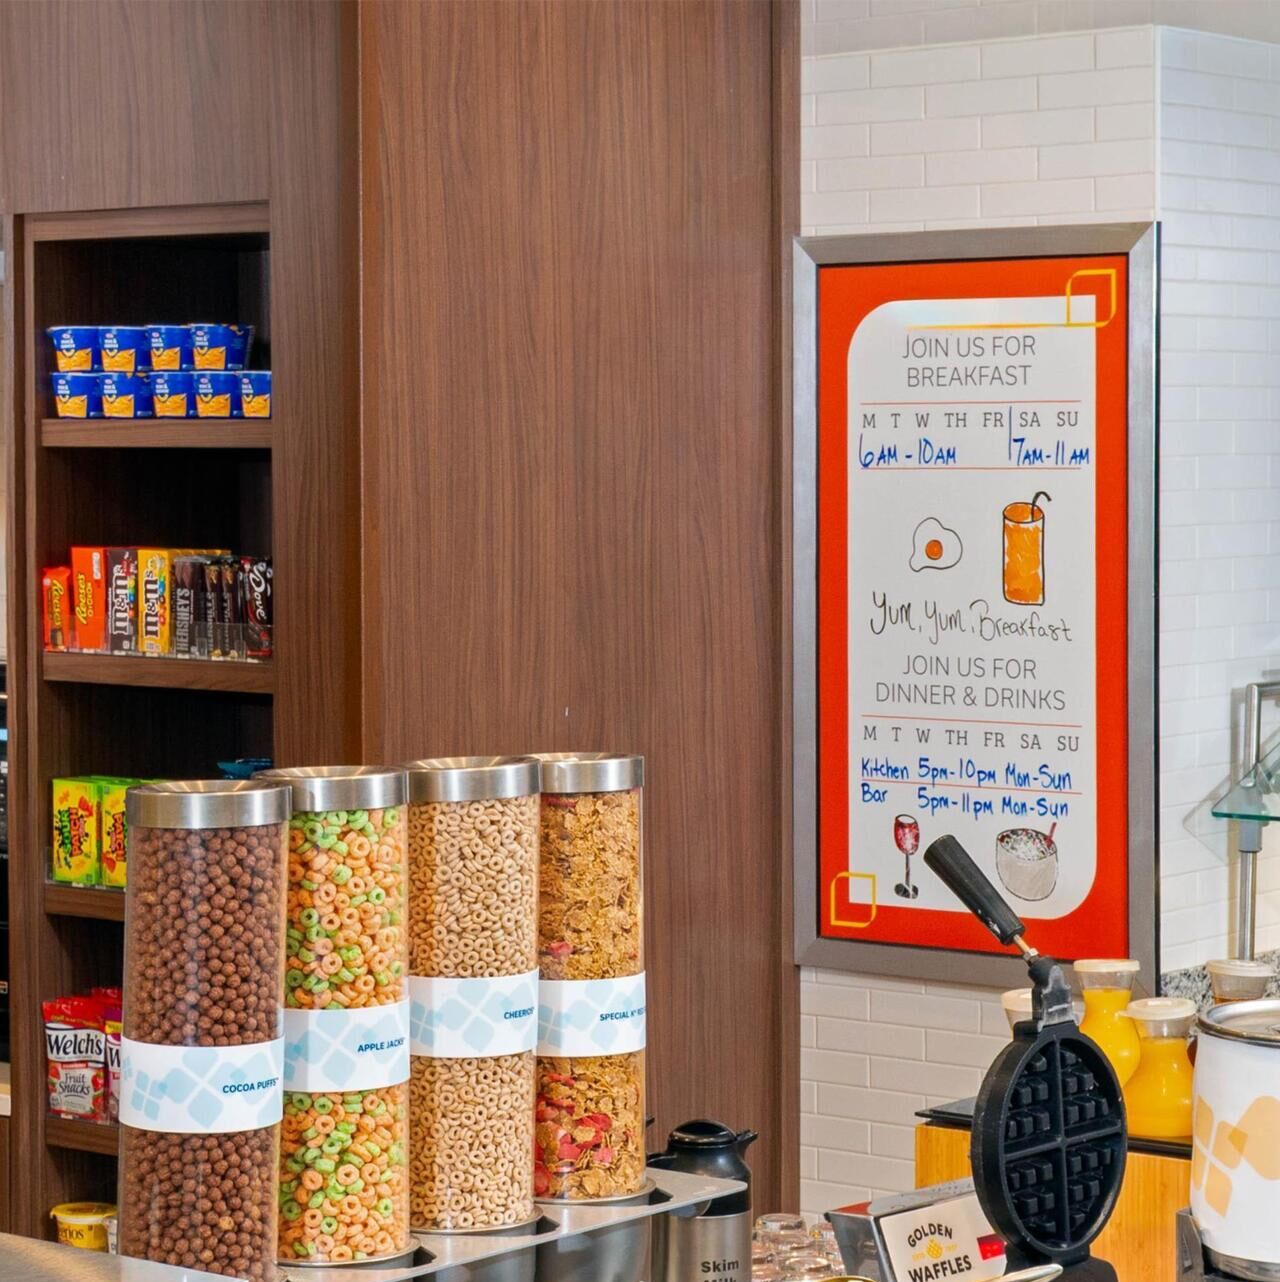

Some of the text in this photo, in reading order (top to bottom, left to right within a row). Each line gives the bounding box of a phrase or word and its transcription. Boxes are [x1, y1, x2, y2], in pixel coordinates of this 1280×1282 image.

[902, 335, 1036, 359] JOIN US FOR
[907, 365, 1032, 388] BREAKFAST
[863, 411, 1079, 429] M T W TH FR SA SU
[249, 565, 267, 621] Dove
[969, 599, 1073, 642] Breakfast
[902, 655, 1036, 680] JOIN US FOR
[876, 682, 1066, 711] DINNER & DRINKS
[863, 725, 1079, 752] M T W TH FR SA SU
[861, 757, 909, 780] Kitchen
[861, 783, 888, 803] Bar
[600, 1011, 630, 1022] SPECIAL
[47, 1033, 103, 1056] Welch's
[357, 1042, 385, 1053] APPLE
[58, 1081, 90, 1096] Snacks
[222, 1082, 255, 1094] COCOA
[907, 1223, 953, 1248] GOLDEN
[701, 1259, 739, 1273] Skim
